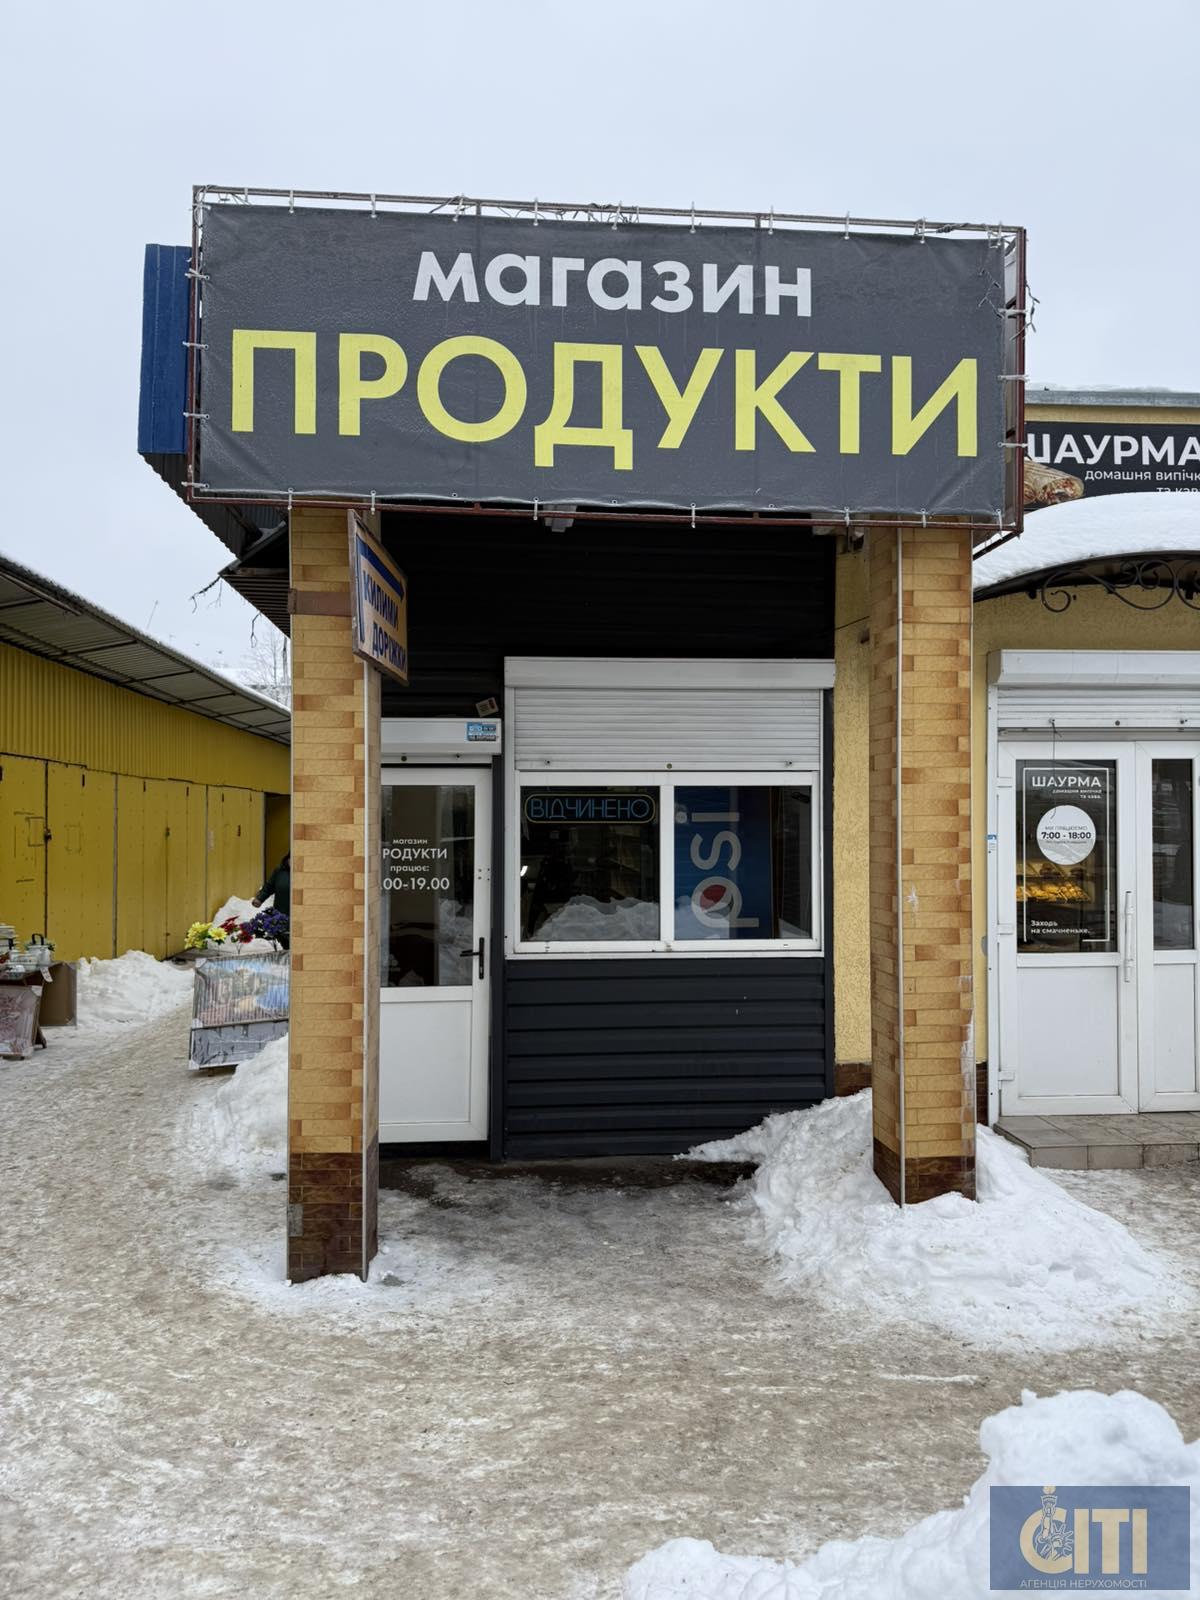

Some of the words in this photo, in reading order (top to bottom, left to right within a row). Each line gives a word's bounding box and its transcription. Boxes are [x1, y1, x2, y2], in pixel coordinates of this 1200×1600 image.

[413, 250, 811, 318] магазин
[231, 328, 978, 471] ПРОДУКТИ
[1084, 470, 1151, 481] домашня
[1032, 776, 1102, 787] ШАУРМА
[530, 798, 650, 819] ВІДЧИНЕНО
[1041, 831, 1061, 839] 7:00
[1068, 831, 1091, 839] 18:00
